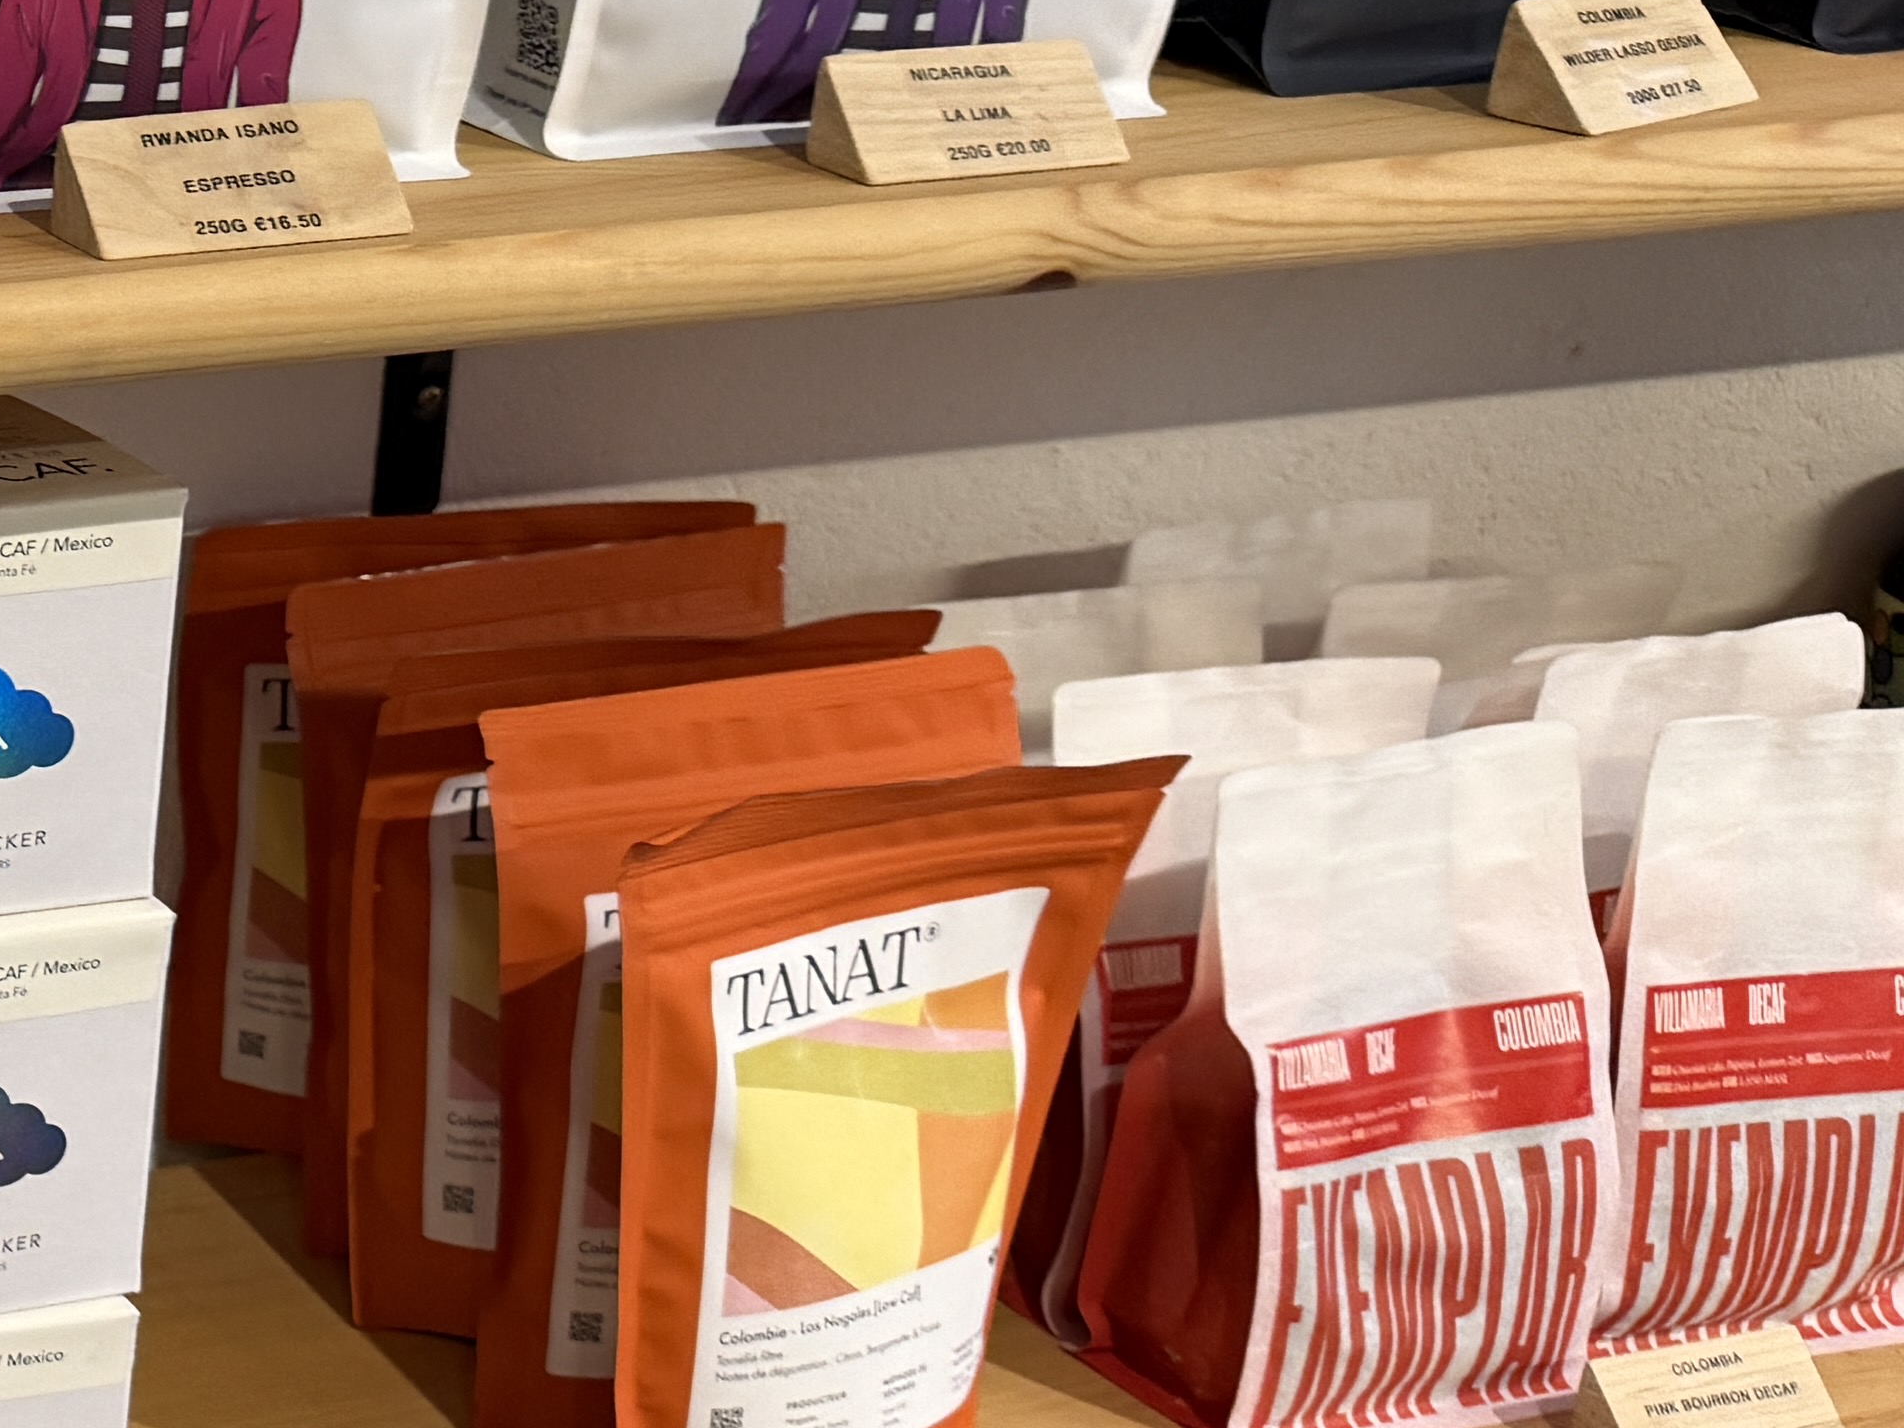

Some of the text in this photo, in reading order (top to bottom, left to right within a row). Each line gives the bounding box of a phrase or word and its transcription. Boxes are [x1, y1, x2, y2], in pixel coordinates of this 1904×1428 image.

[1577, 6, 1647, 24] COLOMBIA
[1563, 34, 1706, 66] WILDER LASSO GEISHA
[909, 65, 1012, 81] NICARAGUA
[942, 107, 1012, 122] LA LIMA
[141, 119, 299, 148] RWANDA ISANO
[947, 139, 1051, 160] 250G €20.00
[183, 170, 296, 194] ESPRESSO
[195, 218, 248, 235] 250G
[53, 533, 114, 553] Mexico
[43, 957, 100, 975] Mexico
[1748, 982, 1786, 1026] DECAF
[1493, 1000, 1581, 1052] COLOMBIA
[7, 1350, 64, 1367] Mexico
[1671, 1351, 1743, 1376] COLOMBIA
[1644, 1381, 1799, 1418] PINK BOURBON DECAF
